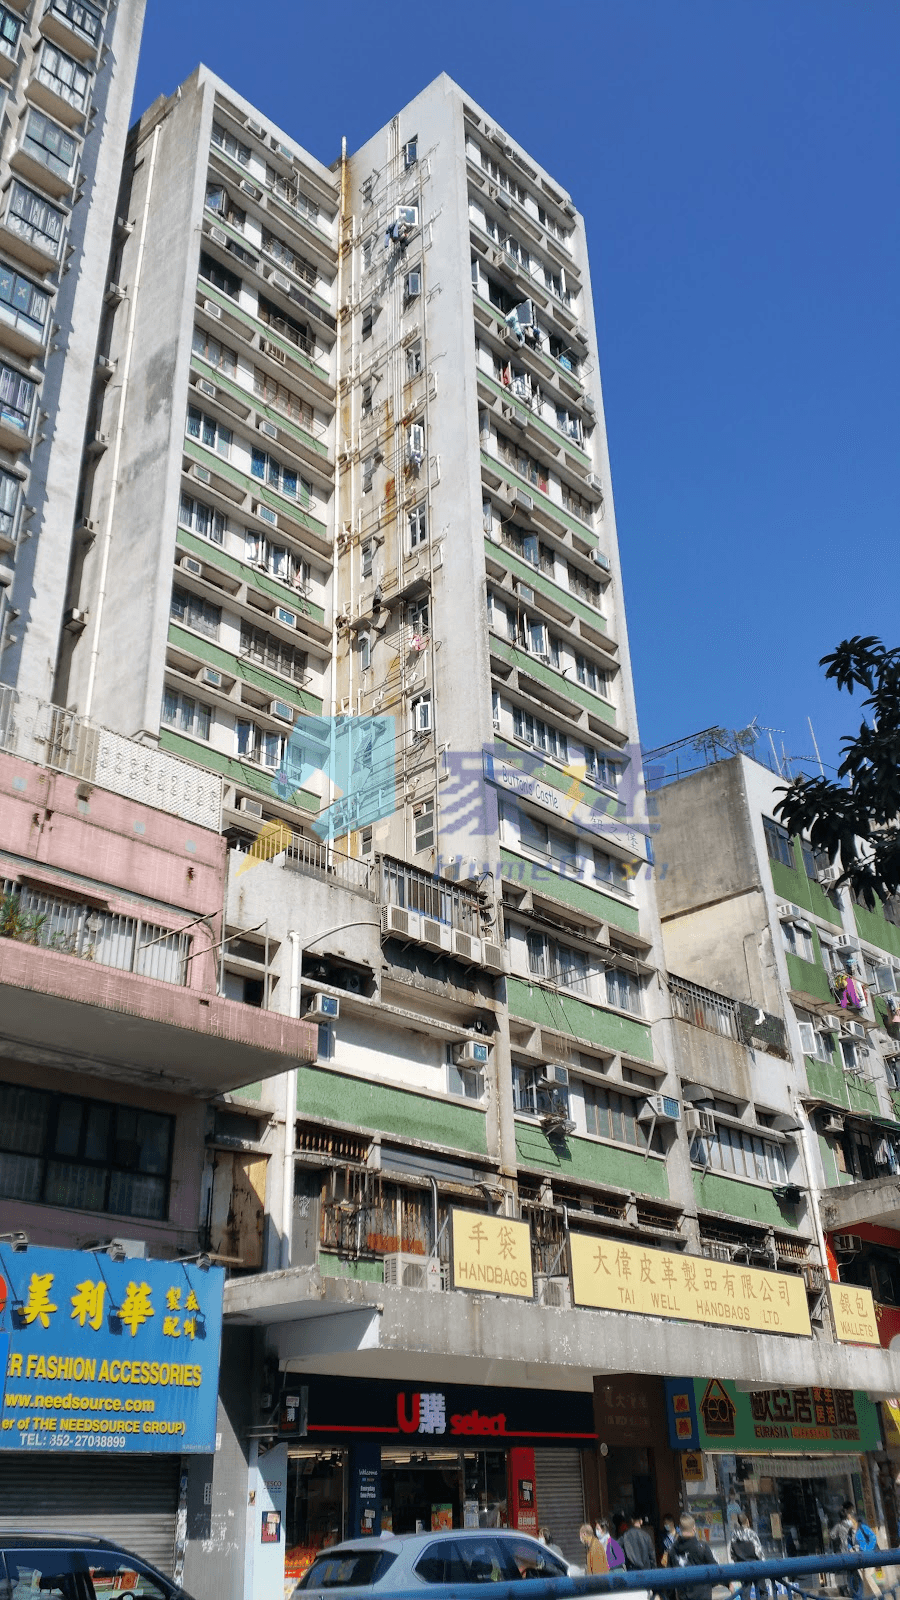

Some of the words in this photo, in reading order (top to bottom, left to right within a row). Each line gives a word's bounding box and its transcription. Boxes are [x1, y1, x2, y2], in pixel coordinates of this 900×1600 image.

[535, 783, 559, 809] Castle
[469, 1221, 516, 1260] 手袋
[459, 1261, 528, 1288] HANDBAGS
[592, 1245, 791, 1306] 大偉皮革製品有限公司
[17, 1272, 155, 1337] 美利華
[617, 1287, 636, 1305] TAI
[650, 1292, 681, 1312] WELL
[696, 1299, 751, 1321] HANDBAGS
[762, 1309, 783, 1326] LTD.
[839, 1292, 868, 1318] 銀包
[840, 1320, 874, 1337] WALLETS
[26, 1354, 97, 1382] FASHION
[98, 1359, 203, 1388] ACCESSORIES
[17, 1417, 30, 1430] of
[32, 1417, 57, 1431] THE
[60, 1418, 140, 1434] NEEDSOURCE
[142, 1421, 186, 1436] GROUP)
[20, 1433, 47, 1446] TEL:
[754, 1424, 789, 1439] EURASIA
[832, 1427, 860, 1441] STORE
